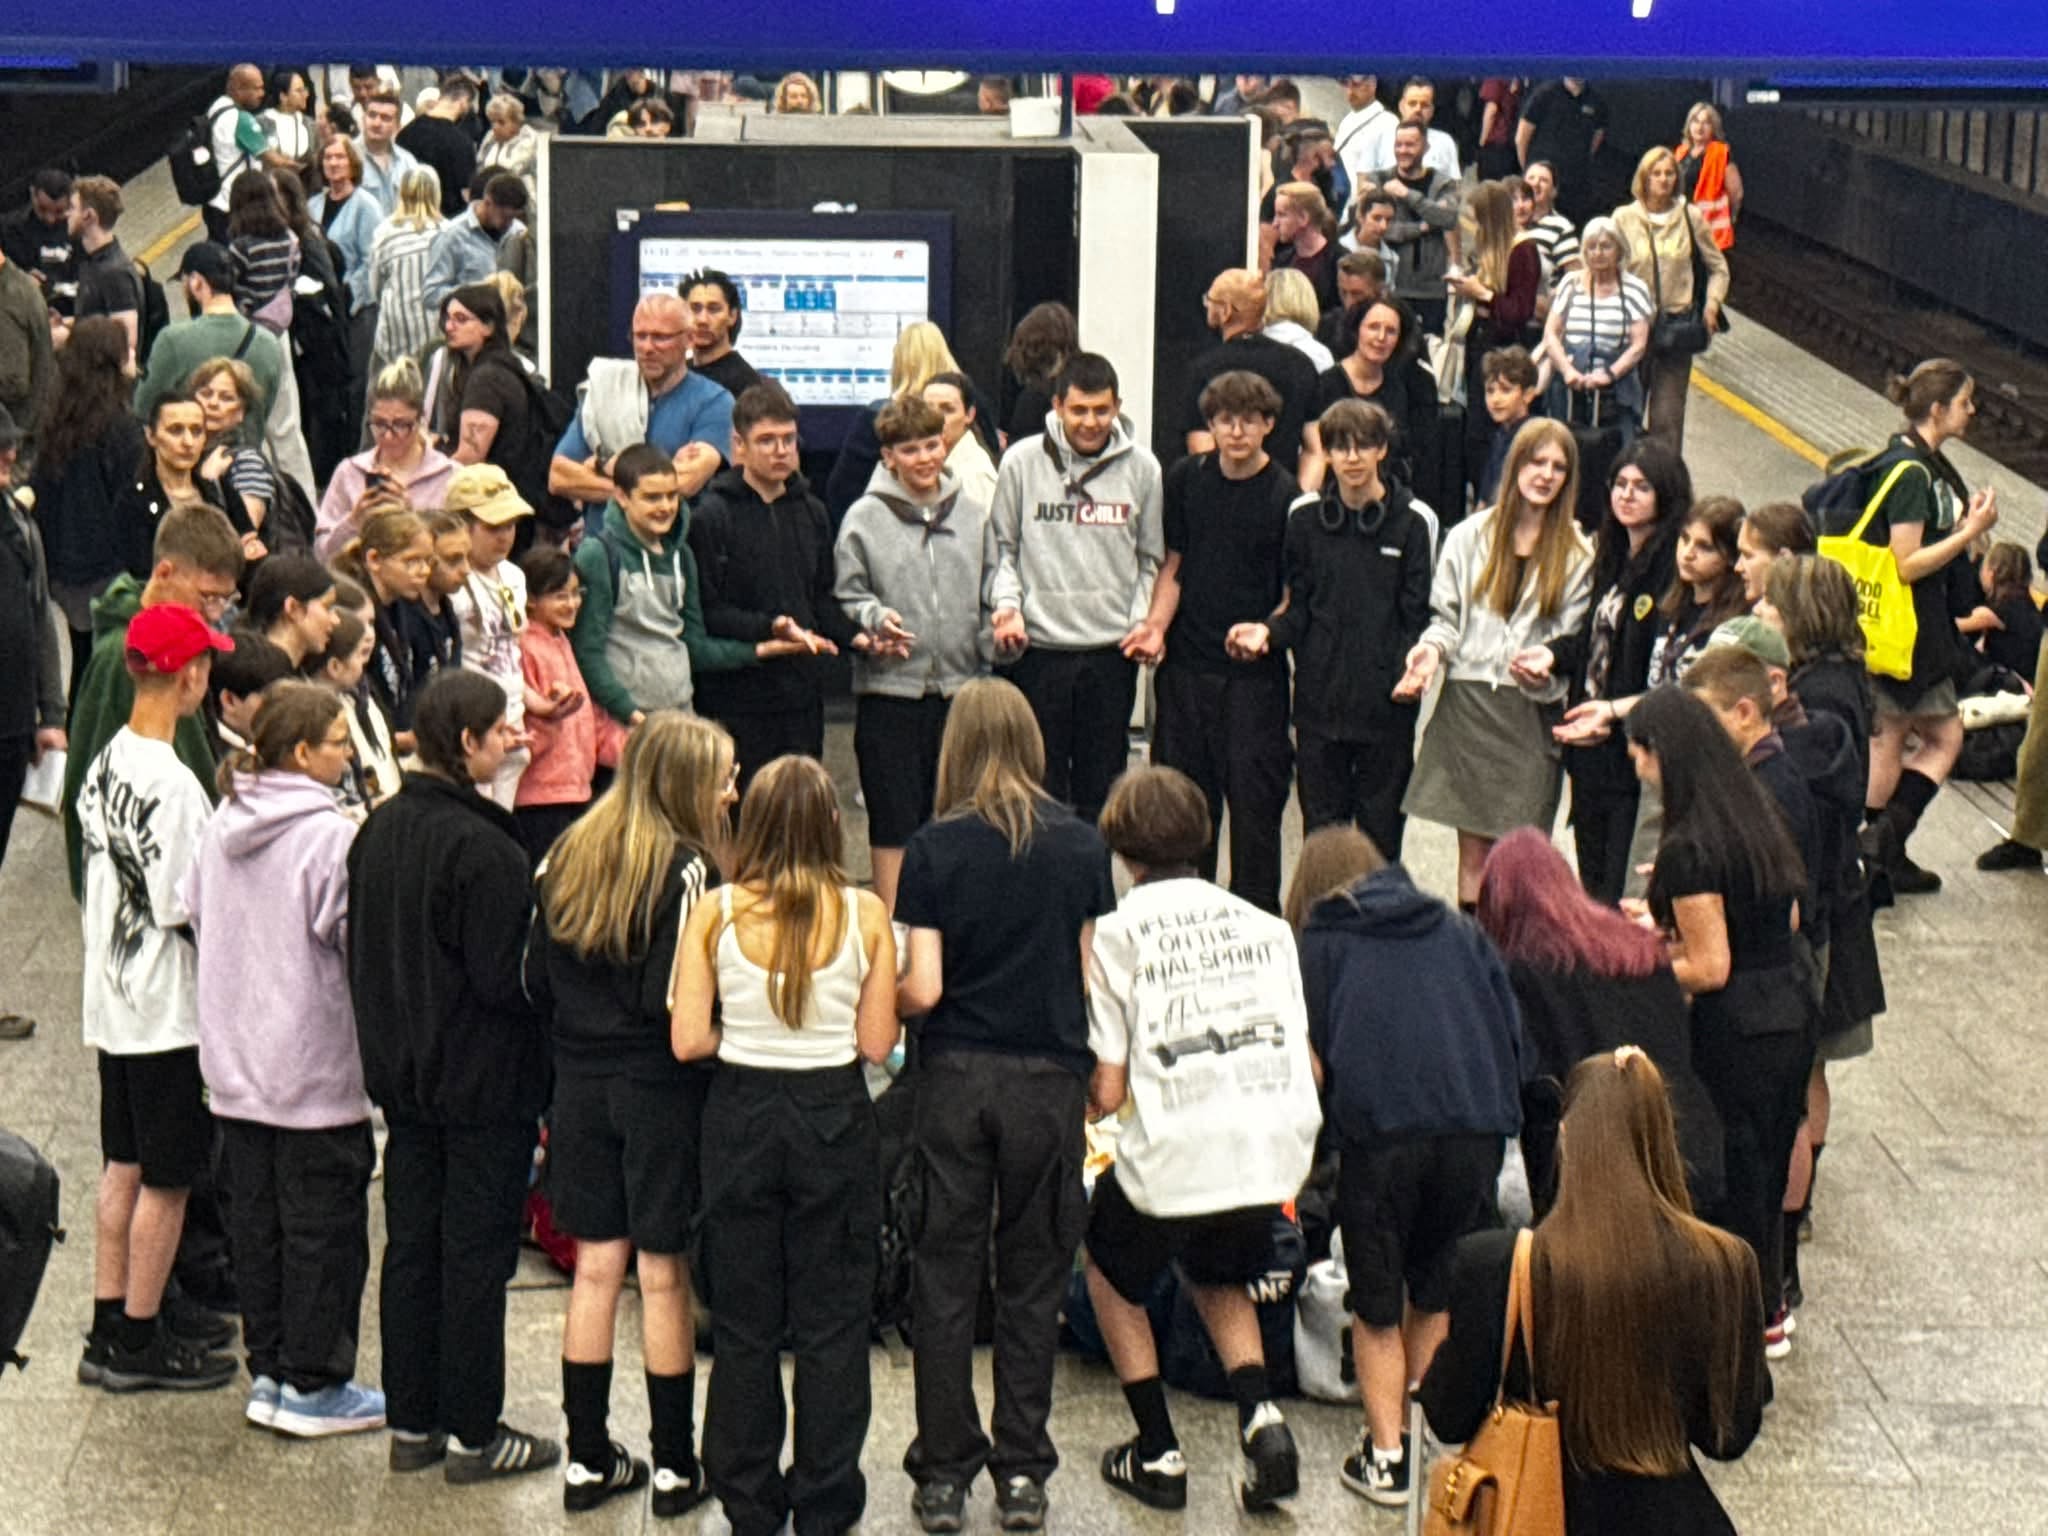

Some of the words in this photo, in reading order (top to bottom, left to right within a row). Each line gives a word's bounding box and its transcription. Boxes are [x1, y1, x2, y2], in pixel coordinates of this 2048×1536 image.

[1034, 502, 1076, 523] JUST
[1080, 503, 1127, 524] CHILL
[1855, 577, 1882, 599] OOD
[1158, 931, 1193, 954] ON
[1196, 925, 1240, 949] THE
[1134, 954, 1197, 989] FINAL
[1199, 940, 1273, 970] SPRINT
